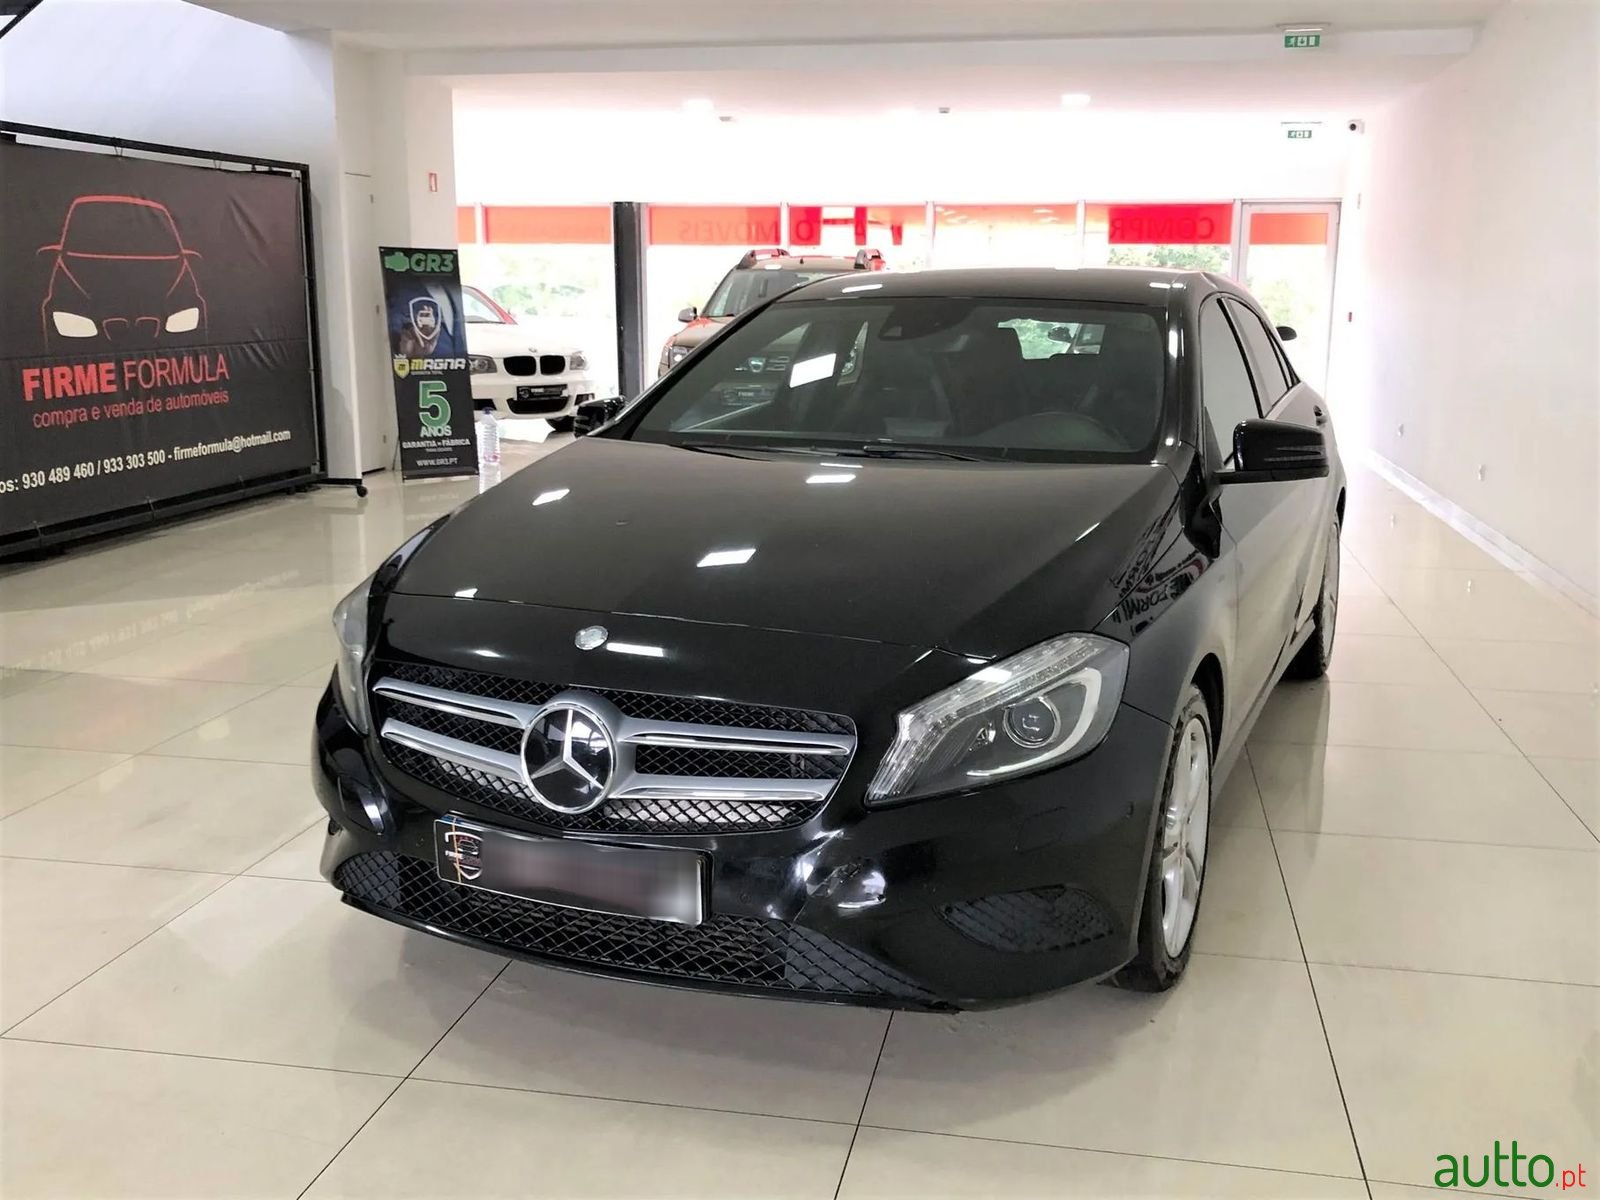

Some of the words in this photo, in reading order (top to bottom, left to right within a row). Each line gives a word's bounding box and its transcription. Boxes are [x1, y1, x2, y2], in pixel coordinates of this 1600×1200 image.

[410, 252, 454, 272] GR3
[22, 363, 118, 401] FIRME
[123, 353, 230, 391] FORMULA
[410, 358, 466, 370] MAGNA
[33, 405, 88, 429] compra
[91, 406, 100, 420] e
[103, 397, 144, 419] venda
[147, 396, 162, 413] de
[166, 388, 229, 411] automóveis
[419, 380, 452, 428] 5
[402, 440, 437, 449] GARANTIA
[420, 425, 452, 438] ANOS
[22, 467, 46, 490] 930
[48, 464, 71, 486] 489
[73, 460, 95, 480] 460
[103, 454, 124, 474] 933
[126, 452, 145, 471] 303
[147, 448, 166, 467] 500
[174, 428, 291, 462] firmeformula@hotmail.com
